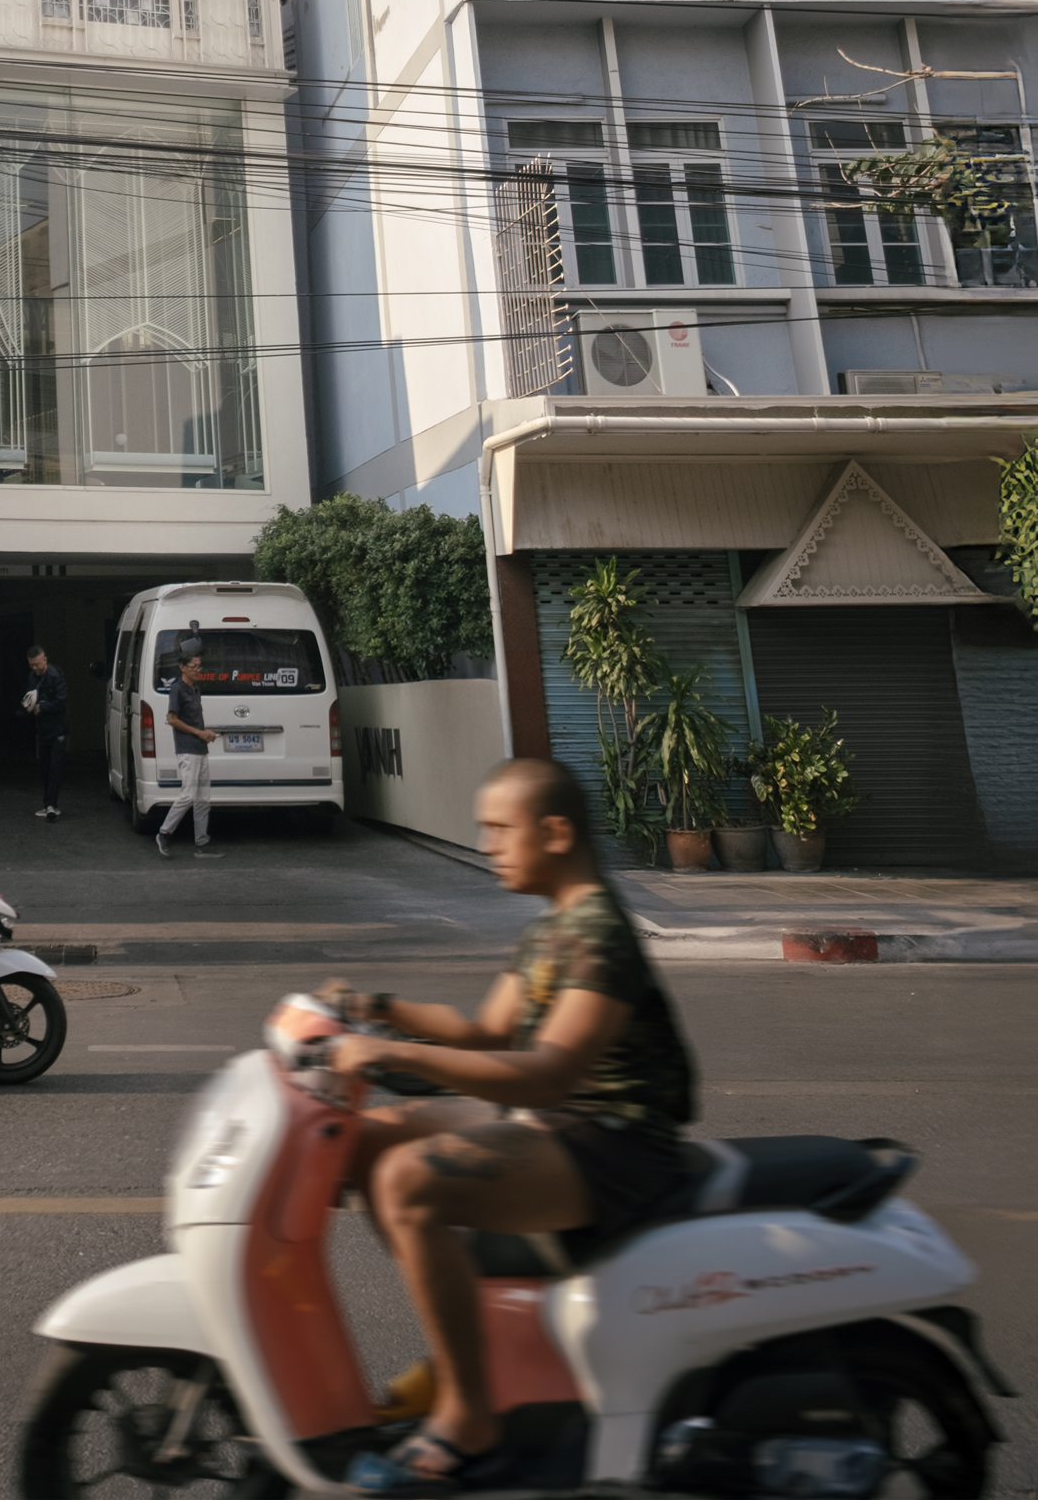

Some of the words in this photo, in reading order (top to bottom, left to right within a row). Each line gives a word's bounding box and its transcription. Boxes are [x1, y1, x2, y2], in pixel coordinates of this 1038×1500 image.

[218, 672, 229, 681] OF
[232, 669, 261, 681] PURPLE
[281, 674, 295, 684] 09
[243, 735, 261, 743] 5042
